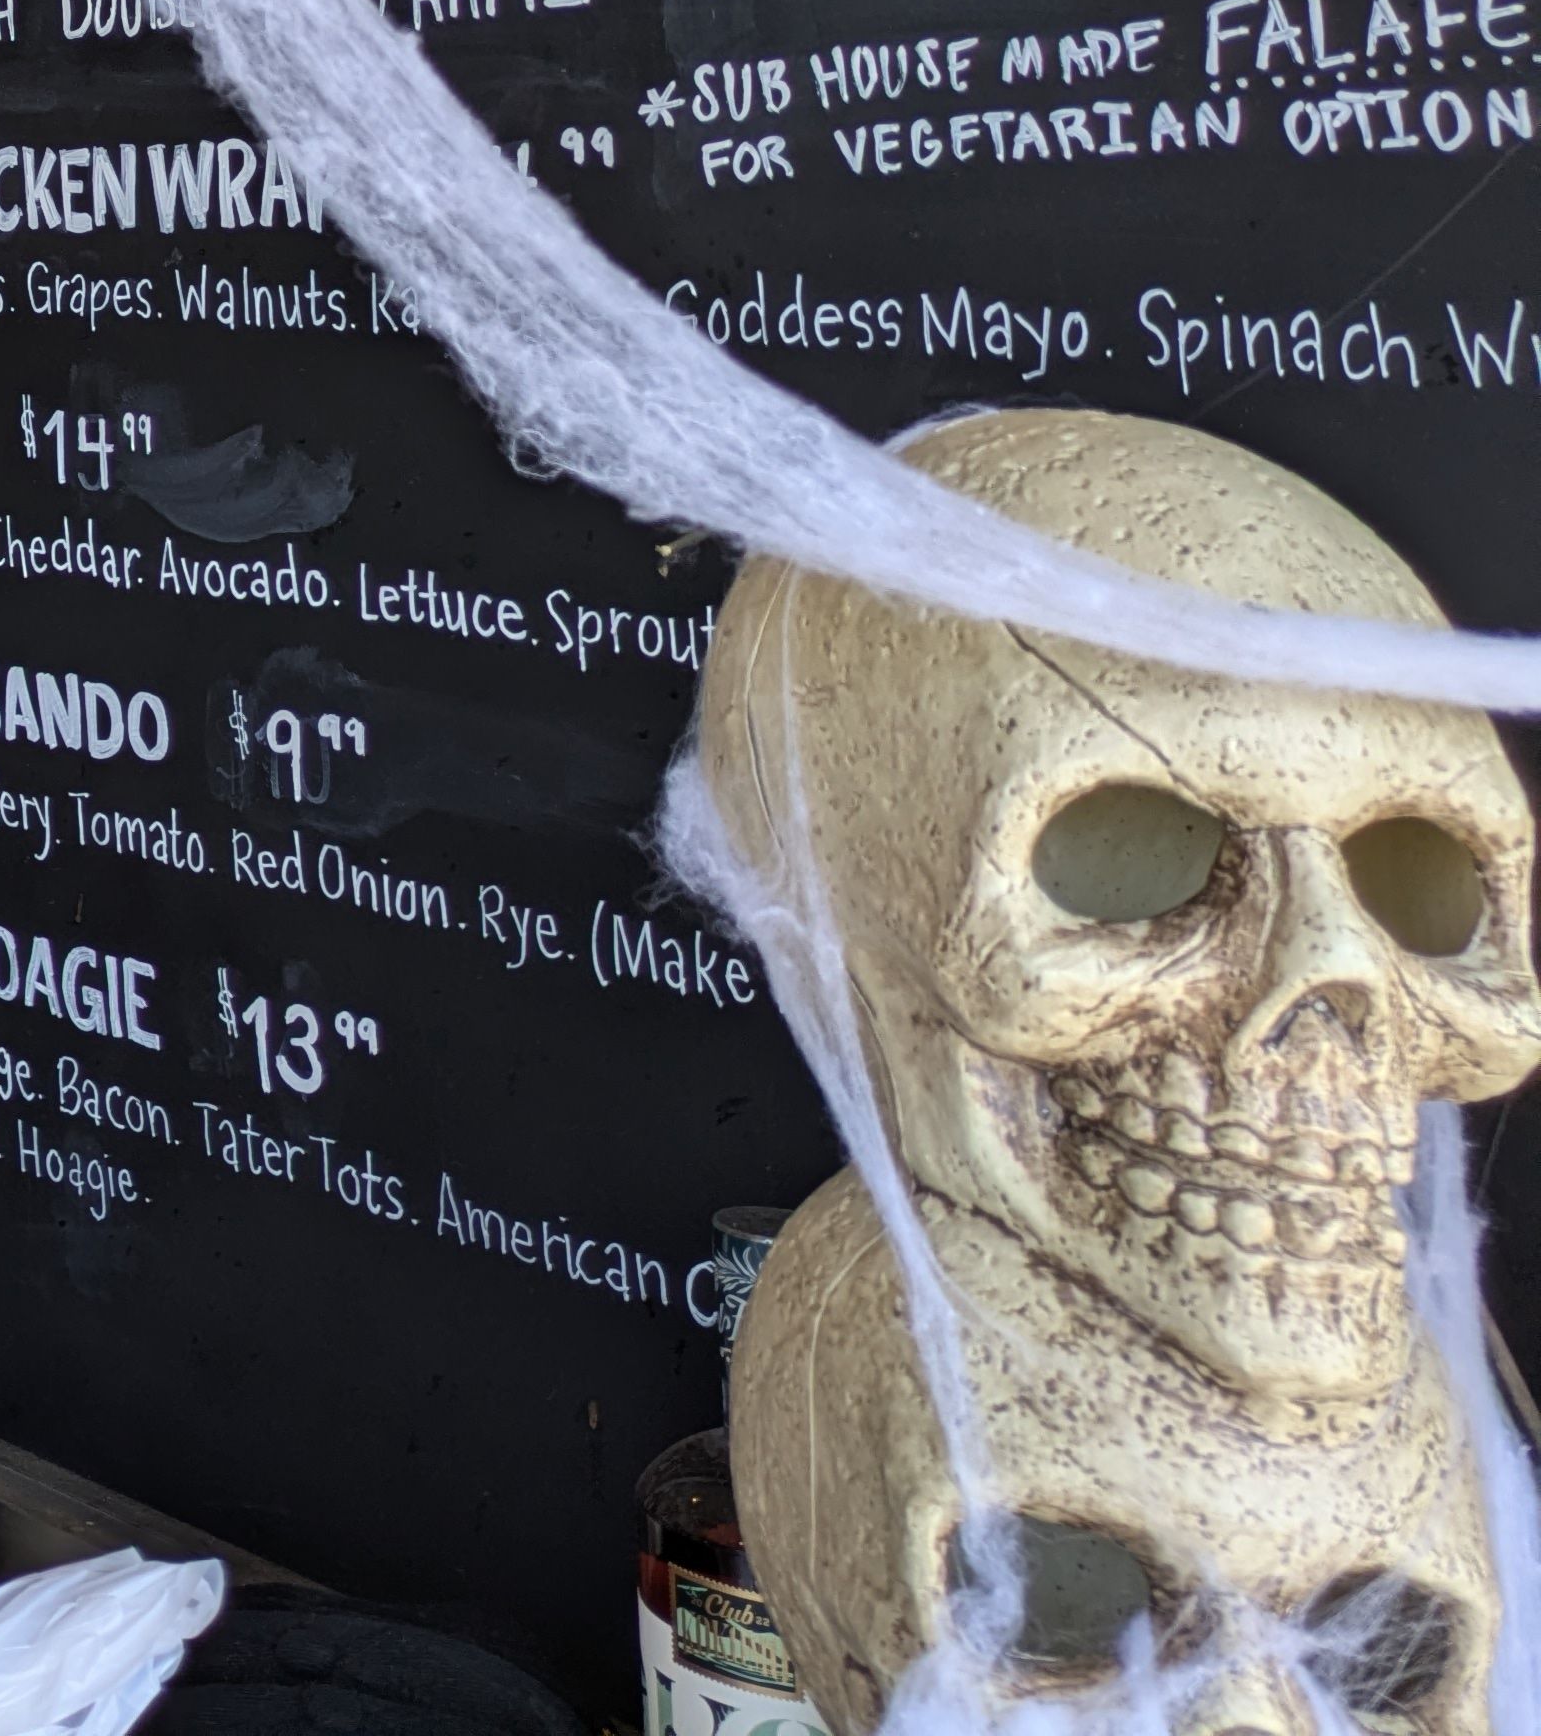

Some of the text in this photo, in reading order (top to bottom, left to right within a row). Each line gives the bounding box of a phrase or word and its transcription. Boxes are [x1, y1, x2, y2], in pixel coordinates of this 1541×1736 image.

[810, 19, 1165, 107] HOUSE MADE
[702, 97, 1241, 186] FOR VEGETARIAN
[27, 262, 162, 331] Grapes.
[175, 265, 355, 332] Walnuts.
[922, 286, 1112, 380] Mayo.
[1139, 289, 1419, 395] Spinach
[159, 539, 341, 608] Avocado.
[359, 564, 539, 646] Lettuce.
[68, 792, 214, 875] Tomato.
[232, 828, 305, 894] Red
[318, 845, 466, 930] Onion.
[479, 884, 575, 968] Rye.
[19, 1118, 152, 1221] Hoagie.
[57, 1056, 180, 1145] Bacon.
[193, 1101, 305, 1182] Tater
[308, 1135, 423, 1227] Tots.
[437, 1172, 669, 1306] American
[705, 1594, 755, 1625] Club
